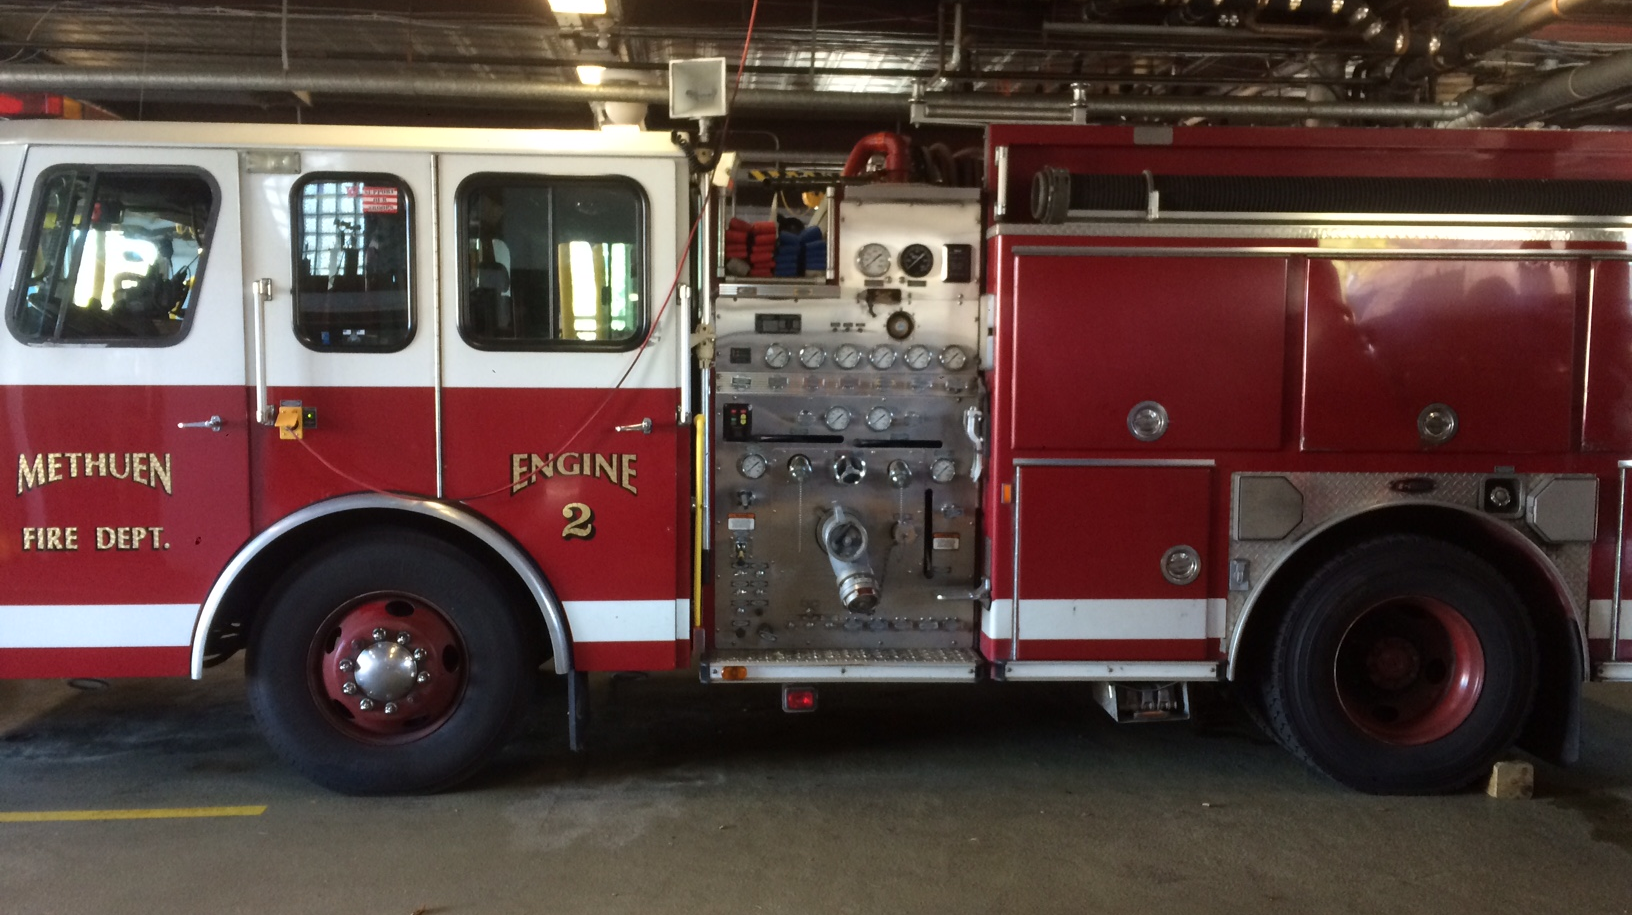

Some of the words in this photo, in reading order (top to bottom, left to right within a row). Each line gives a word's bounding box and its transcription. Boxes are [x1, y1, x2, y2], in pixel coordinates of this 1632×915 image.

[17, 453, 172, 495] METHUEN
[511, 452, 638, 496] ENGINE
[23, 527, 78, 550] FIRE
[96, 527, 170, 550] DEPT.
[562, 503, 596, 540] 2
